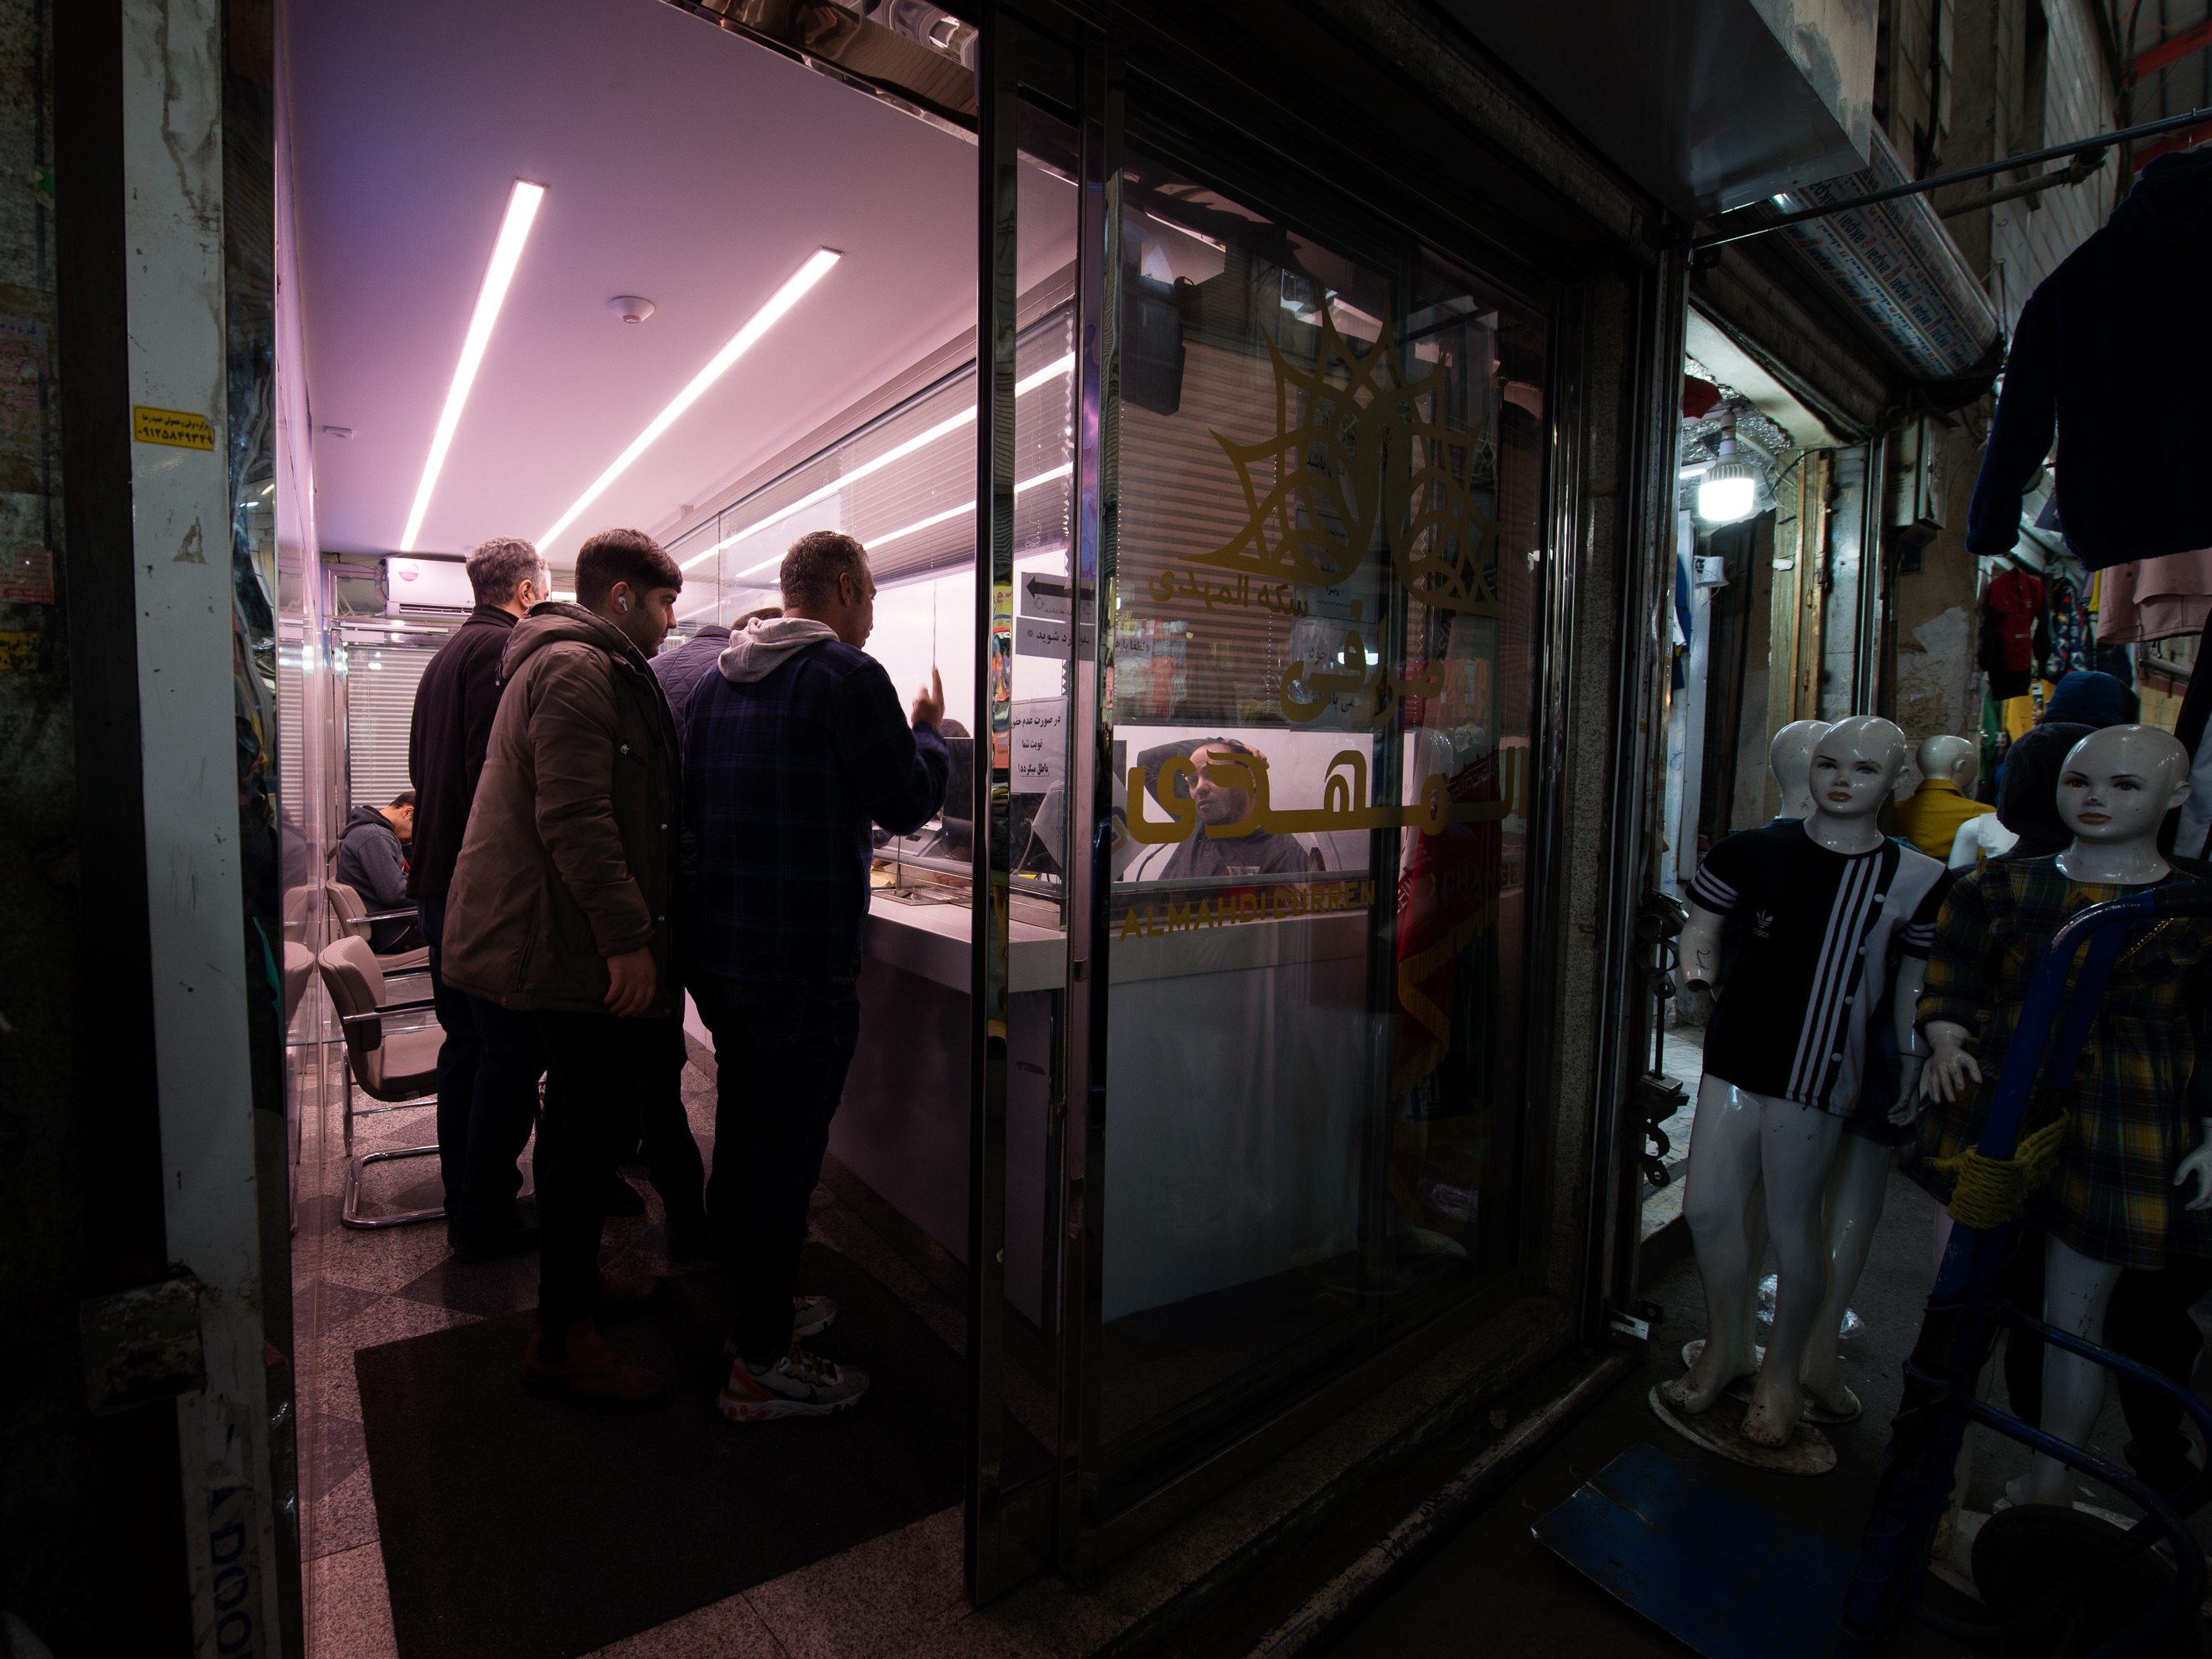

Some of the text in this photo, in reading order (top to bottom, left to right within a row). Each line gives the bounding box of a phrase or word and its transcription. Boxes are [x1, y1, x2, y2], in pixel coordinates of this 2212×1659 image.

[1148, 569, 1309, 617] سکه المهدی
[1036, 631, 1060, 644] شوید
[1021, 717, 1034, 729] عدم
[1034, 717, 1053, 728] صورت
[1053, 716, 1061, 727] در
[1021, 738, 1043, 752] نوبت شما
[1036, 762, 1050, 776] باطل
[1126, 746, 1530, 845] المهدی
[210, 1521, 253, 1659] DOO
